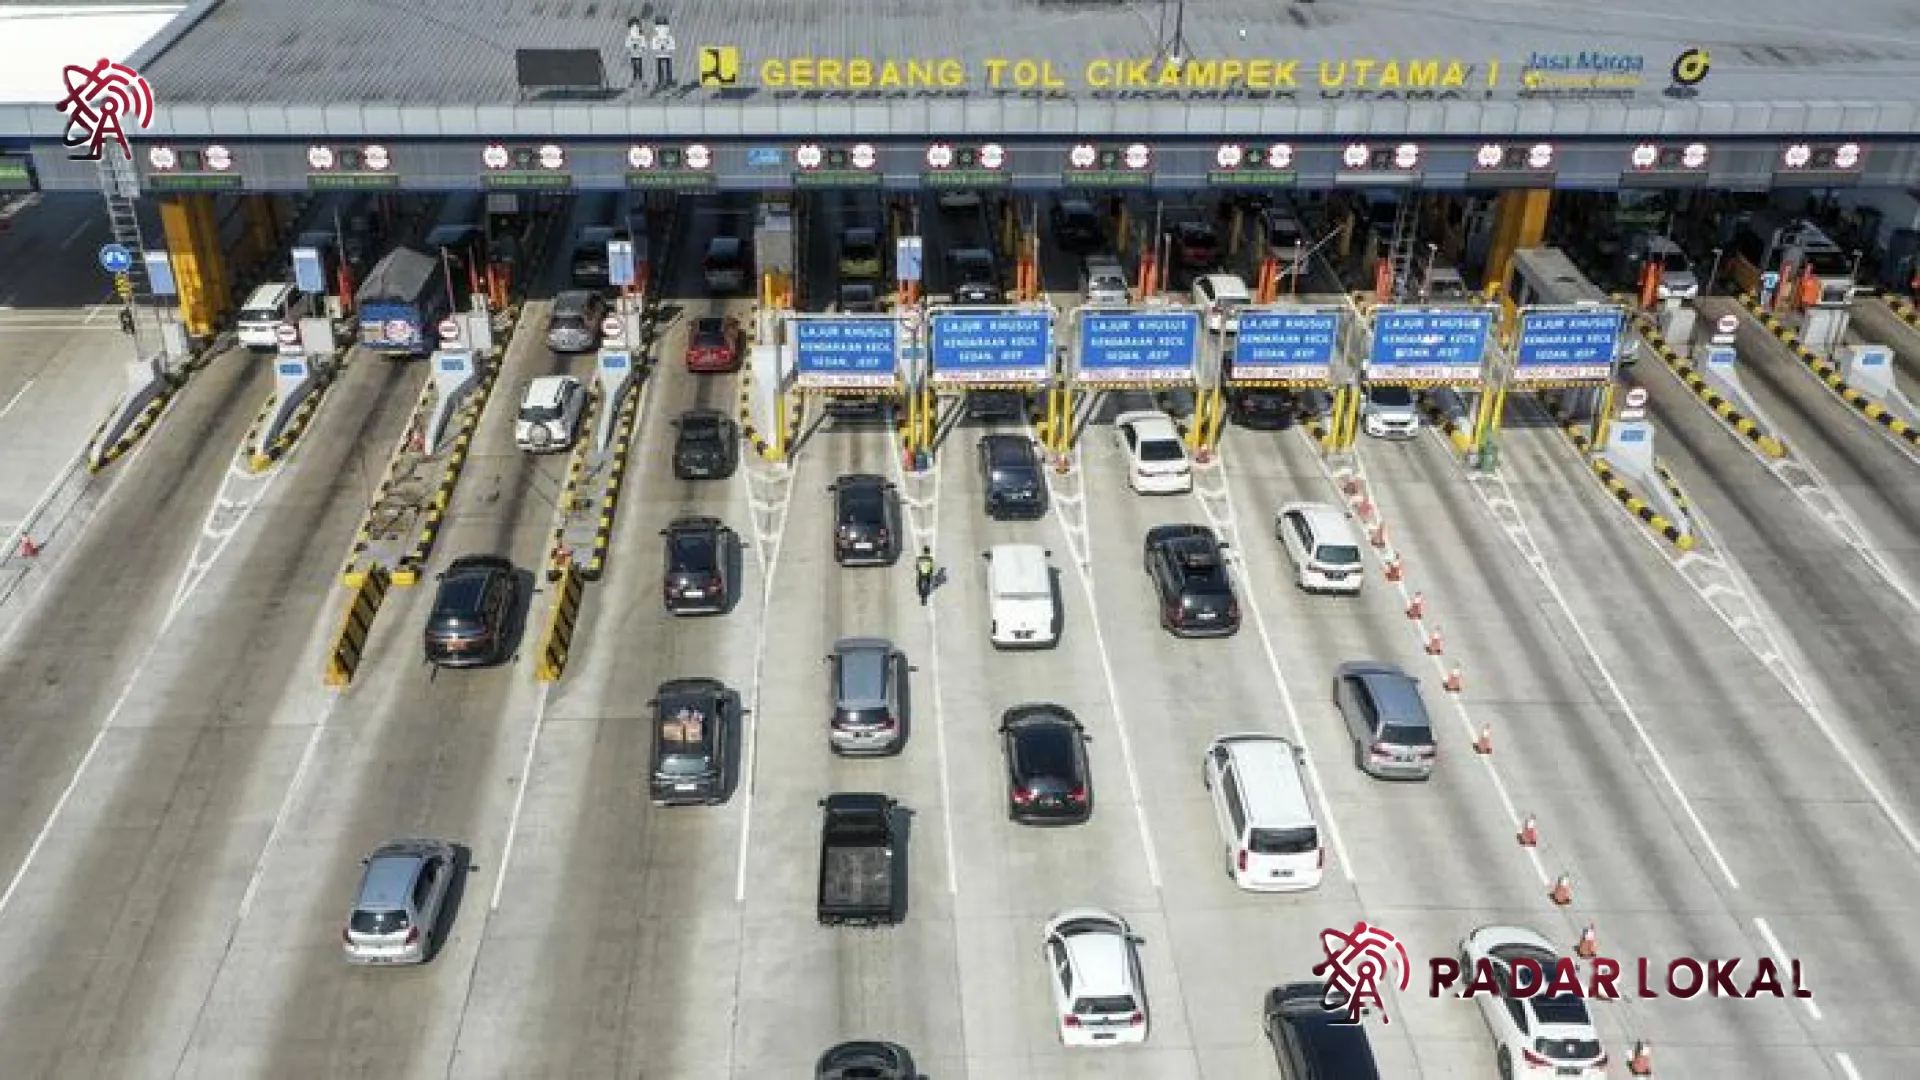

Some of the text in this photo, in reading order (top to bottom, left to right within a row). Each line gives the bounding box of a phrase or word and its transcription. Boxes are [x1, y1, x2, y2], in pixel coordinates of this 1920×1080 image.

[1526, 51, 1644, 74] Jasa Marga
[760, 58, 964, 87] GERBANG
[984, 58, 1064, 87] TOL
[1085, 58, 1297, 88] CIKAMPEK
[1318, 58, 1466, 87] UTAMA
[943, 320, 1040, 332] LAJUR KHUSUS
[1091, 321, 1188, 331] LAJUR KHUSUS
[1242, 318, 1331, 329] LAJUR KHUSUS
[1384, 318, 1481, 329] LAJUR KHUSUS
[1527, 318, 1617, 329] LAJUR KHUSUS
[800, 326, 891, 337] LAJUR KHUSUS
